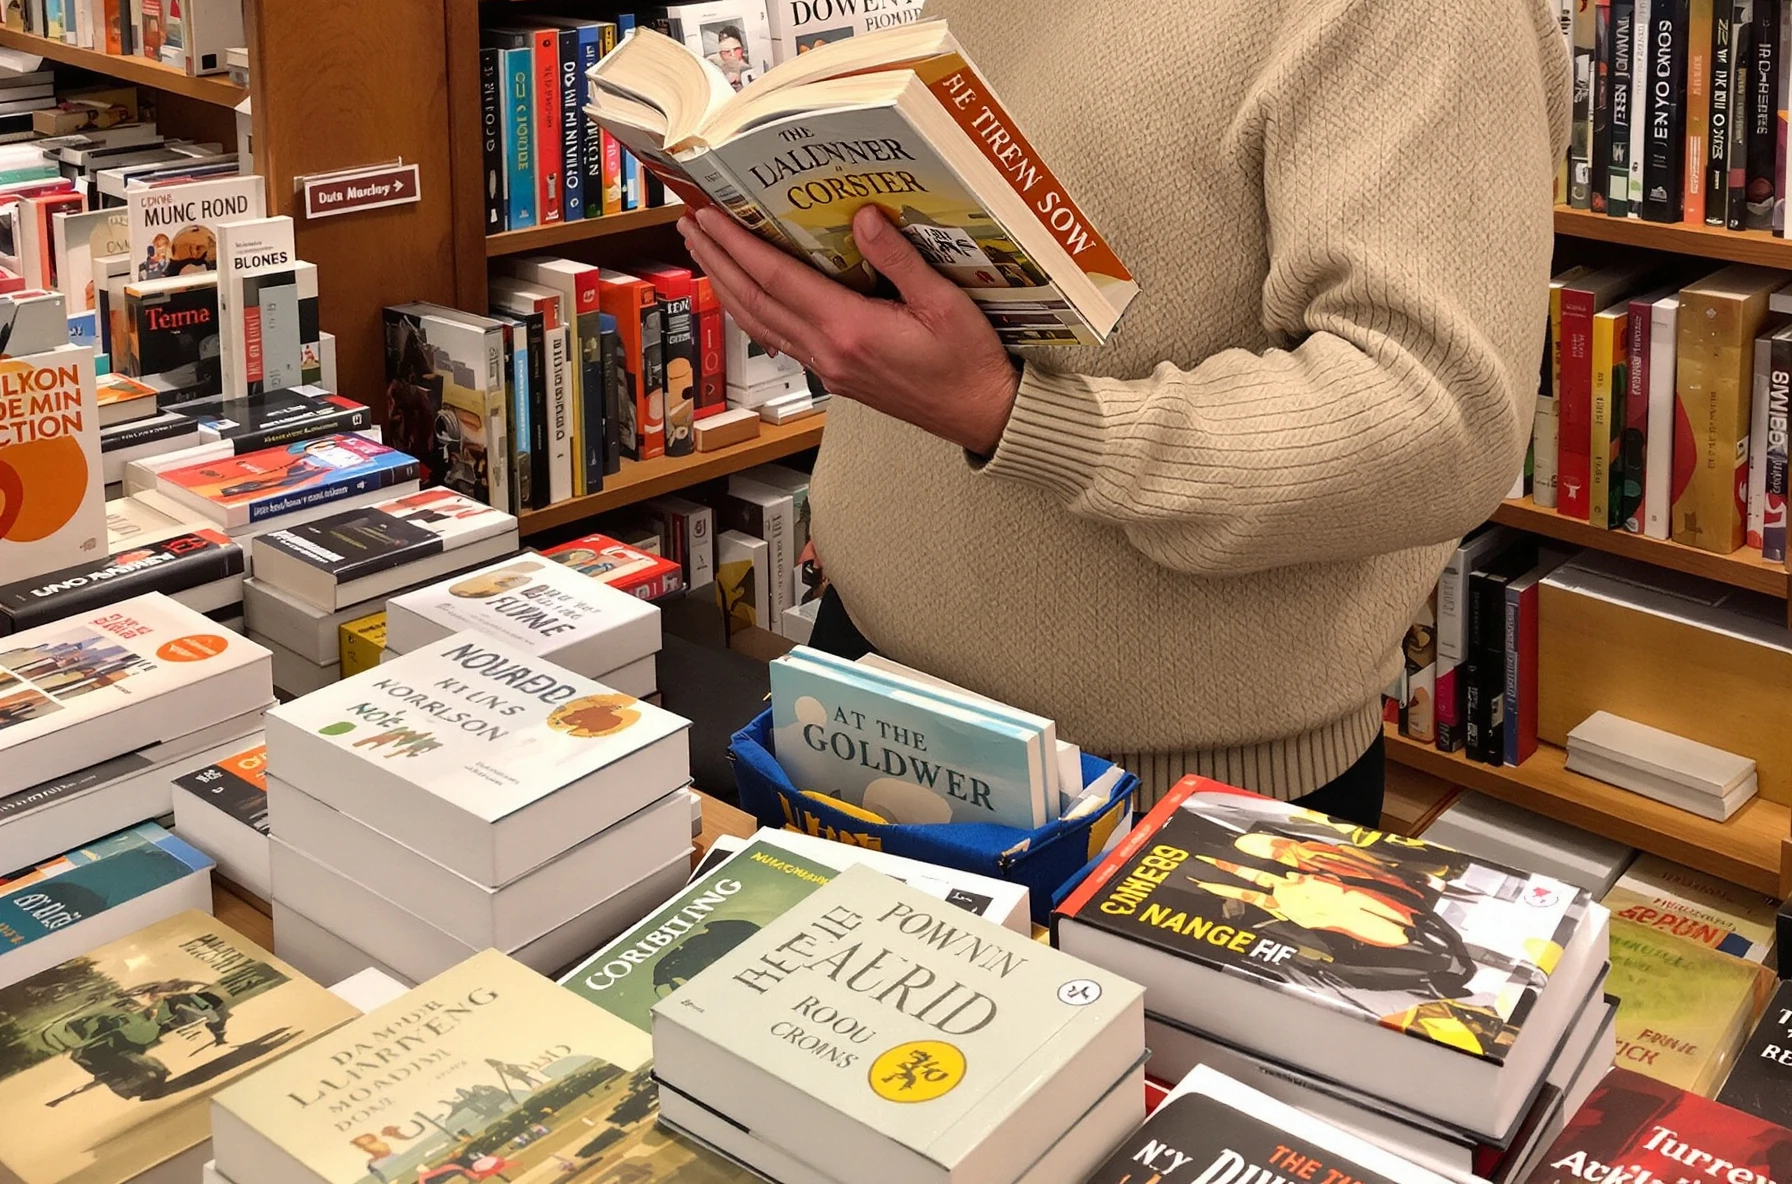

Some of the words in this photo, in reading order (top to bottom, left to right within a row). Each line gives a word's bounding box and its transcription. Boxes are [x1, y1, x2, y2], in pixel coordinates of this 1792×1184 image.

[778, 126, 816, 143] THE
[201, 195, 248, 219] ROND
[1037, 191, 1096, 256] SOW
[234, 251, 288, 270] BLONES
[30, 388, 81, 415] MIN
[833, 705, 866, 730] AT
[875, 719, 927, 752] THE
[803, 722, 997, 813] GOLDWER
[1138, 903, 1257, 954] NANGE
[1268, 1144, 1323, 1181] THE
